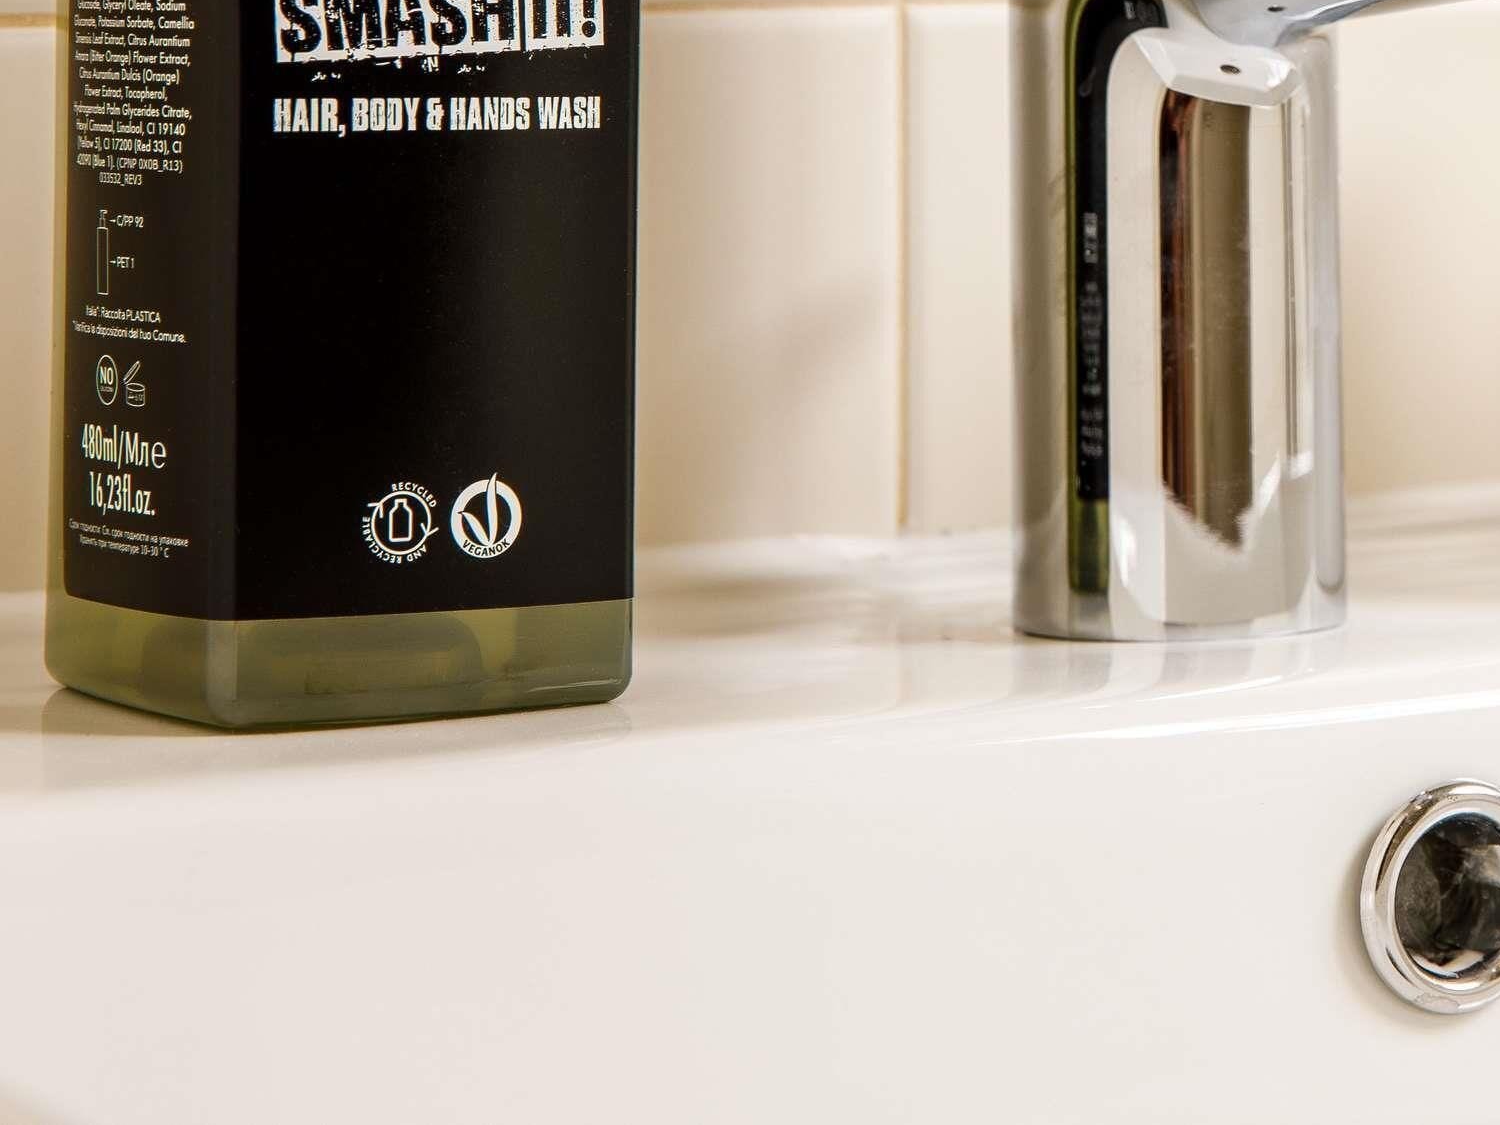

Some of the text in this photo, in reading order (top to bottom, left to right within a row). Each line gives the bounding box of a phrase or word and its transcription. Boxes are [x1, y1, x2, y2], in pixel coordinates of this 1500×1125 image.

[126, 15, 156, 30] Sorbate,
[158, 16, 195, 29] Camellia
[128, 33, 147, 45] Citrus
[149, 34, 191, 47] Aurantium
[133, 50, 157, 63] Flower
[159, 52, 191, 67] Extract,
[121, 68, 140, 81] Dulcis
[142, 68, 180, 85] (Orange)
[125, 86, 168, 102] Tocopherol,
[122, 103, 159, 119] Glycerides
[161, 105, 192, 120] Citrate,
[273, 95, 601, 138] HAIR, BODY & HANDS WASH
[158, 122, 186, 136] 19140
[134, 138, 151, 154] (Red
[134, 216, 144, 228] 92
[100, 366, 114, 385] NO
[89, 471, 155, 516] 16,23fl.oz.
[391, 481, 437, 509] RECYCLED
[362, 516, 402, 564] RECYCLABLE
[462, 539, 511, 557] VEGANOK
[407, 544, 428, 562] AND
